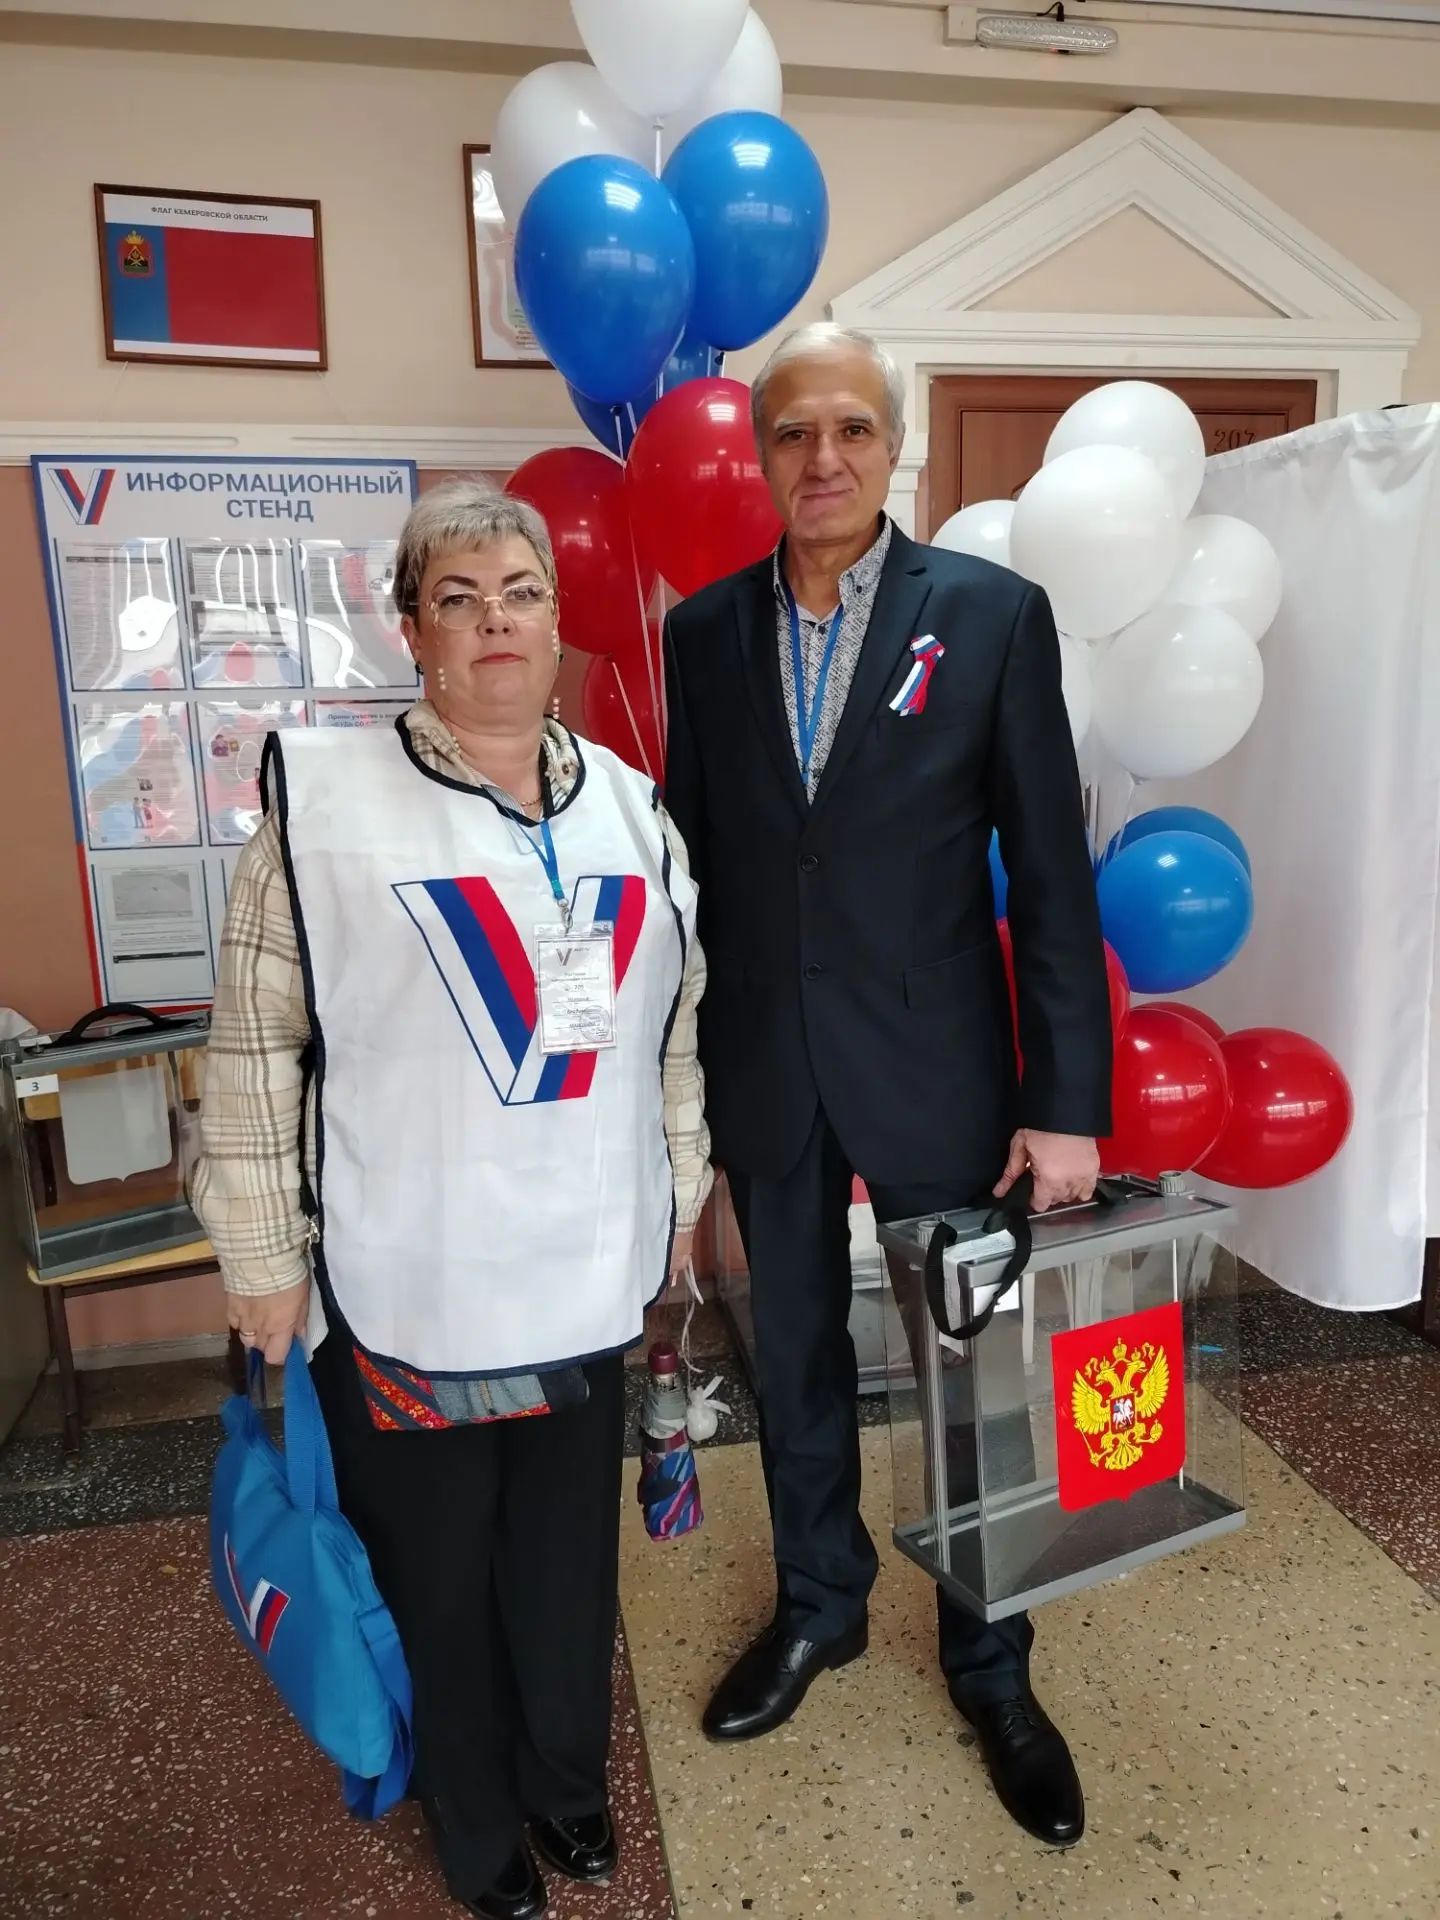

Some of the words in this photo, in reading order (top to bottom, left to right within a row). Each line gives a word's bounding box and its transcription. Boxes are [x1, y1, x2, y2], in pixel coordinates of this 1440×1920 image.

[151, 206, 173, 214] ФЛАГ
[174, 208, 232, 220] КЕМЕРОВСКОЙ
[233, 213, 269, 222] ОБЛАСТИ
[126, 470, 404, 497] ИНФОРМАЦИОННЫЙ
[226, 499, 315, 522] СТЕНД
[31, 1081, 40, 1092] 3
